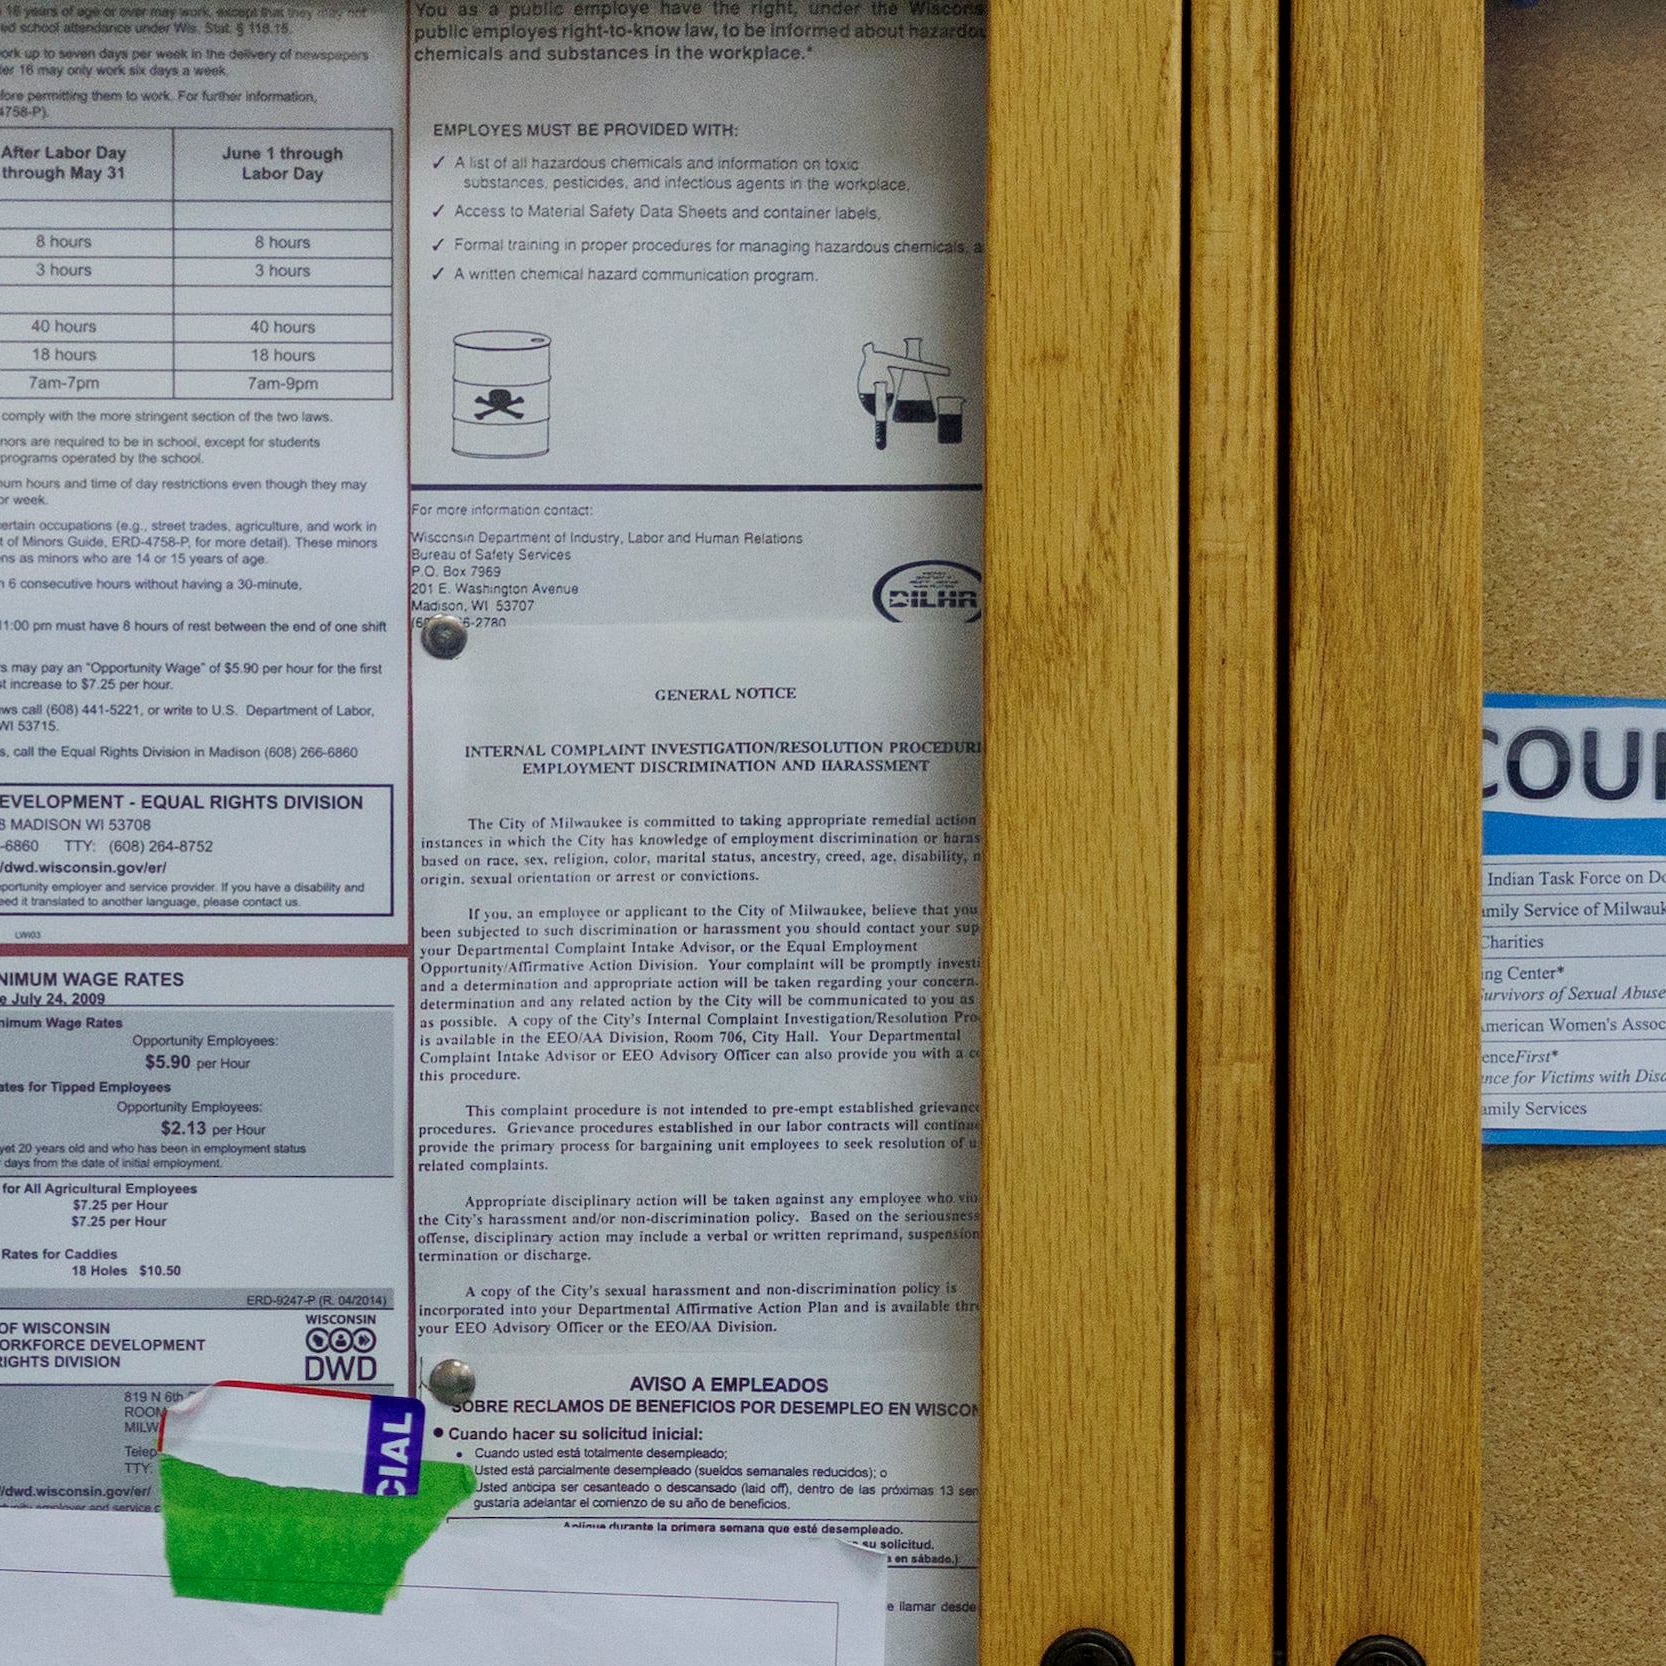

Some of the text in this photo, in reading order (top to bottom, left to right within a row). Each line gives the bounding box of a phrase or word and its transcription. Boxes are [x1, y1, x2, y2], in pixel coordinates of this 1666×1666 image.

[433, 122, 738, 139] EMPLOYES MUST BE PROVIDED WITH:
[35, 233, 93, 249] 8 hours
[29, 375, 100, 393] 7am-7pm
[654, 687, 797, 701] GENERAL NOTICE
[141, 794, 205, 810] EQUAL
[209, 794, 279, 810] RIGHTS
[283, 794, 363, 810] DIVISION
[1487, 871, 1535, 887] Indian
[1538, 870, 1575, 886] Task
[1579, 870, 1622, 886] Force
[1624, 873, 1644, 885] on
[62, 972, 118, 987] WAGE
[124, 972, 184, 987] RATES
[305, 1356, 378, 1382] DWD
[629, 1376, 829, 1394] AVISO A EMPLEADOS
